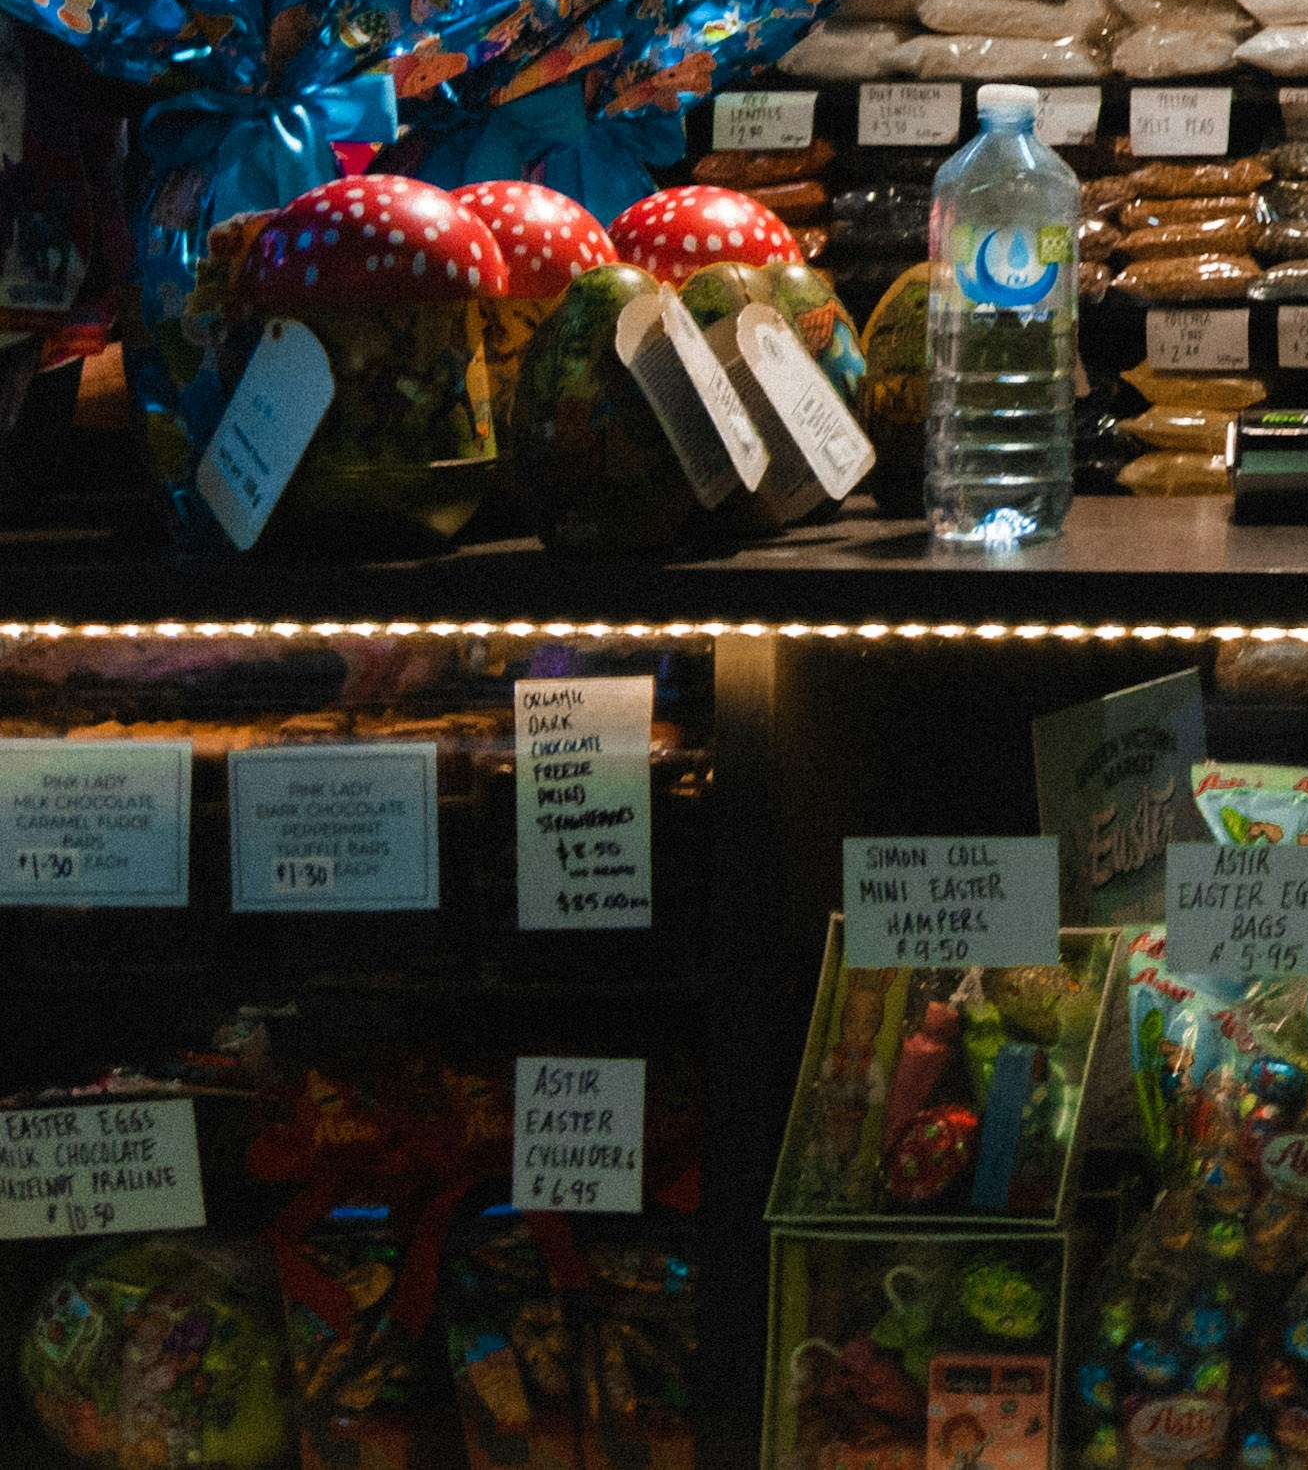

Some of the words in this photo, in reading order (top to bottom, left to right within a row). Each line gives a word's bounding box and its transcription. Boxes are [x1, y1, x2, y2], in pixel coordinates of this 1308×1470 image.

[865, 845, 927, 870] SIMON
[946, 842, 998, 868] COLL
[1212, 845, 1271, 876] ASTIR
[859, 875, 908, 904] MINI
[929, 871, 1007, 904] EASTER
[1177, 880, 1266, 911] EASTER
[885, 907, 989, 936] HAMPERS
[1230, 913, 1289, 942] BAGS
[532, 1065, 603, 1098] ASTIR
[4, 1112, 83, 1143] EASTER
[96, 1109, 158, 1137] EGGS
[525, 1109, 615, 1135] EASTER
[53, 1137, 160, 1169] CHOCOLATE
[524, 1145, 637, 1171] CYLINDERS
[91, 1166, 178, 1195] PRALINE
